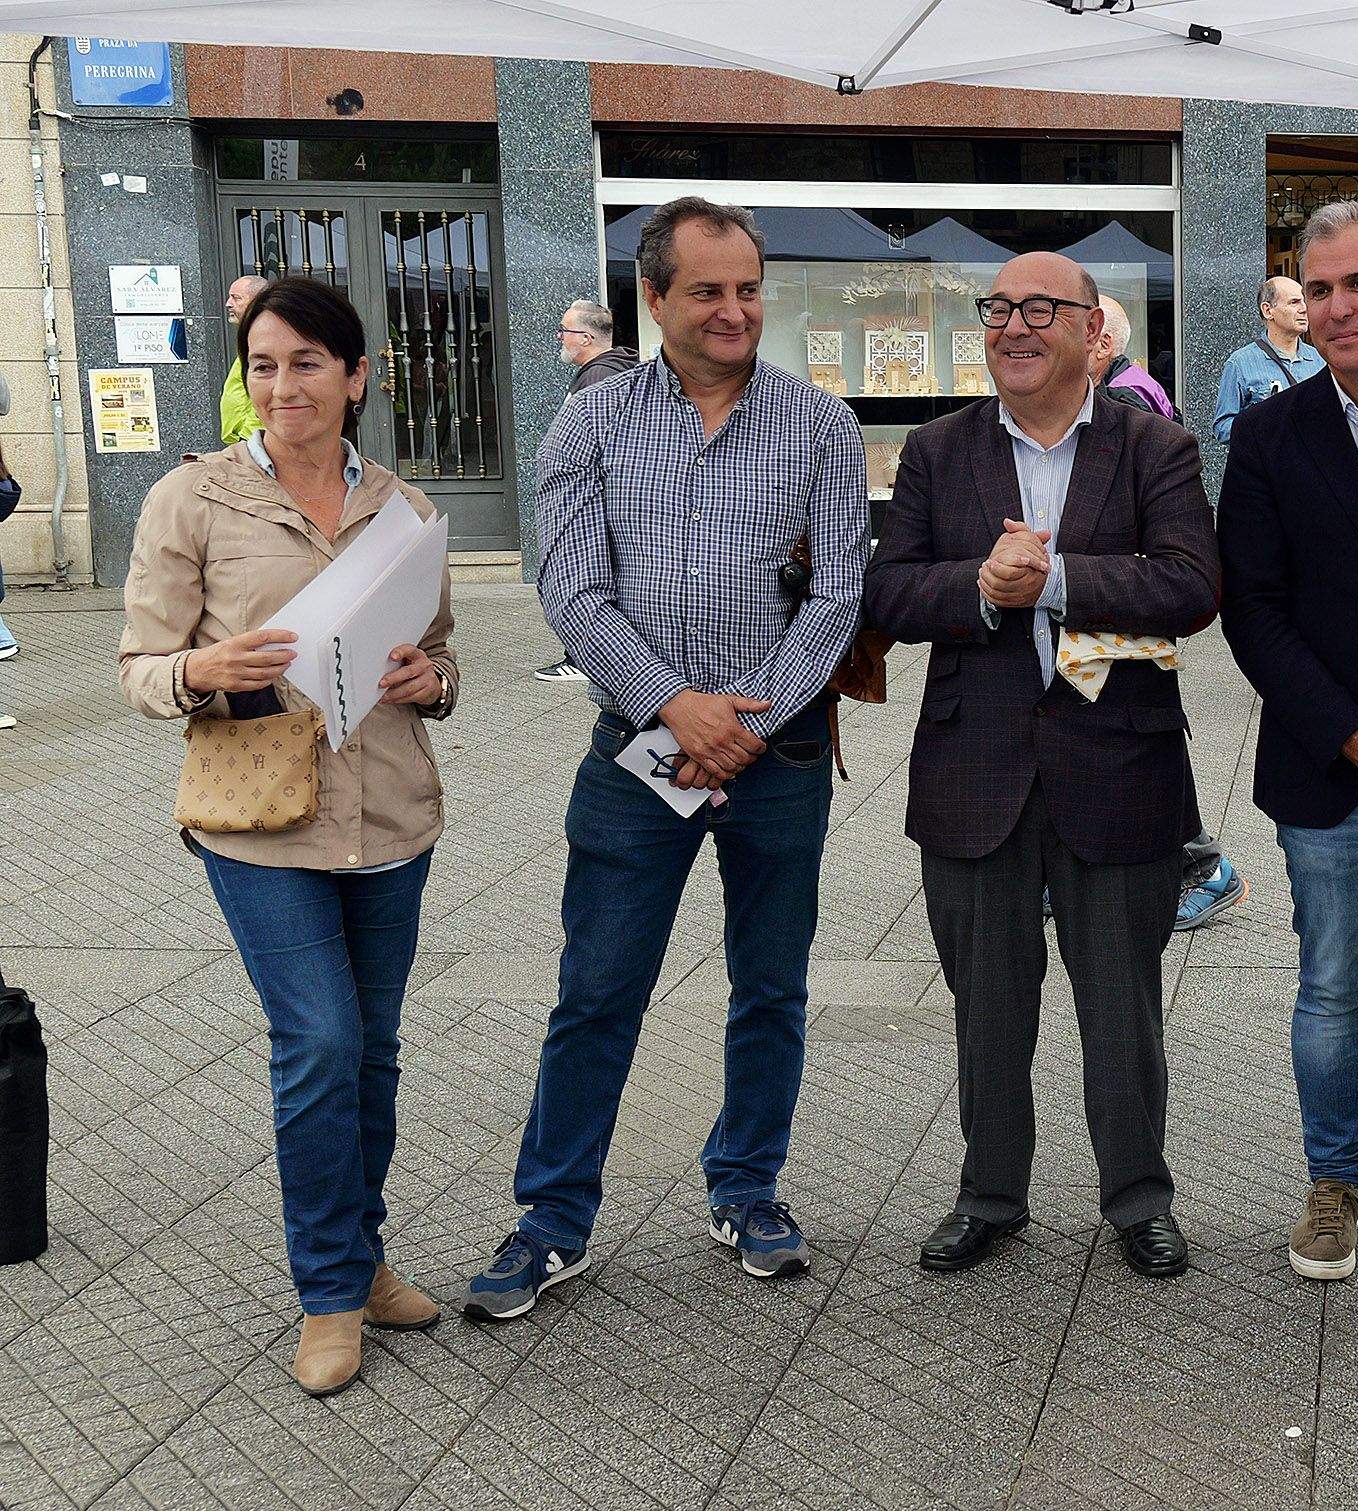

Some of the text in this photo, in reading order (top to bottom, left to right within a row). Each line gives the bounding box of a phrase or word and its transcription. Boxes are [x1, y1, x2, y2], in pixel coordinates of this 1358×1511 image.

[98, 38, 139, 48] PRAZA DA
[84, 64, 156, 79] PEREGRINA
[354, 151, 367, 171] 4
[144, 344, 163, 353] PISO
[100, 376, 141, 384] CAMPUS
